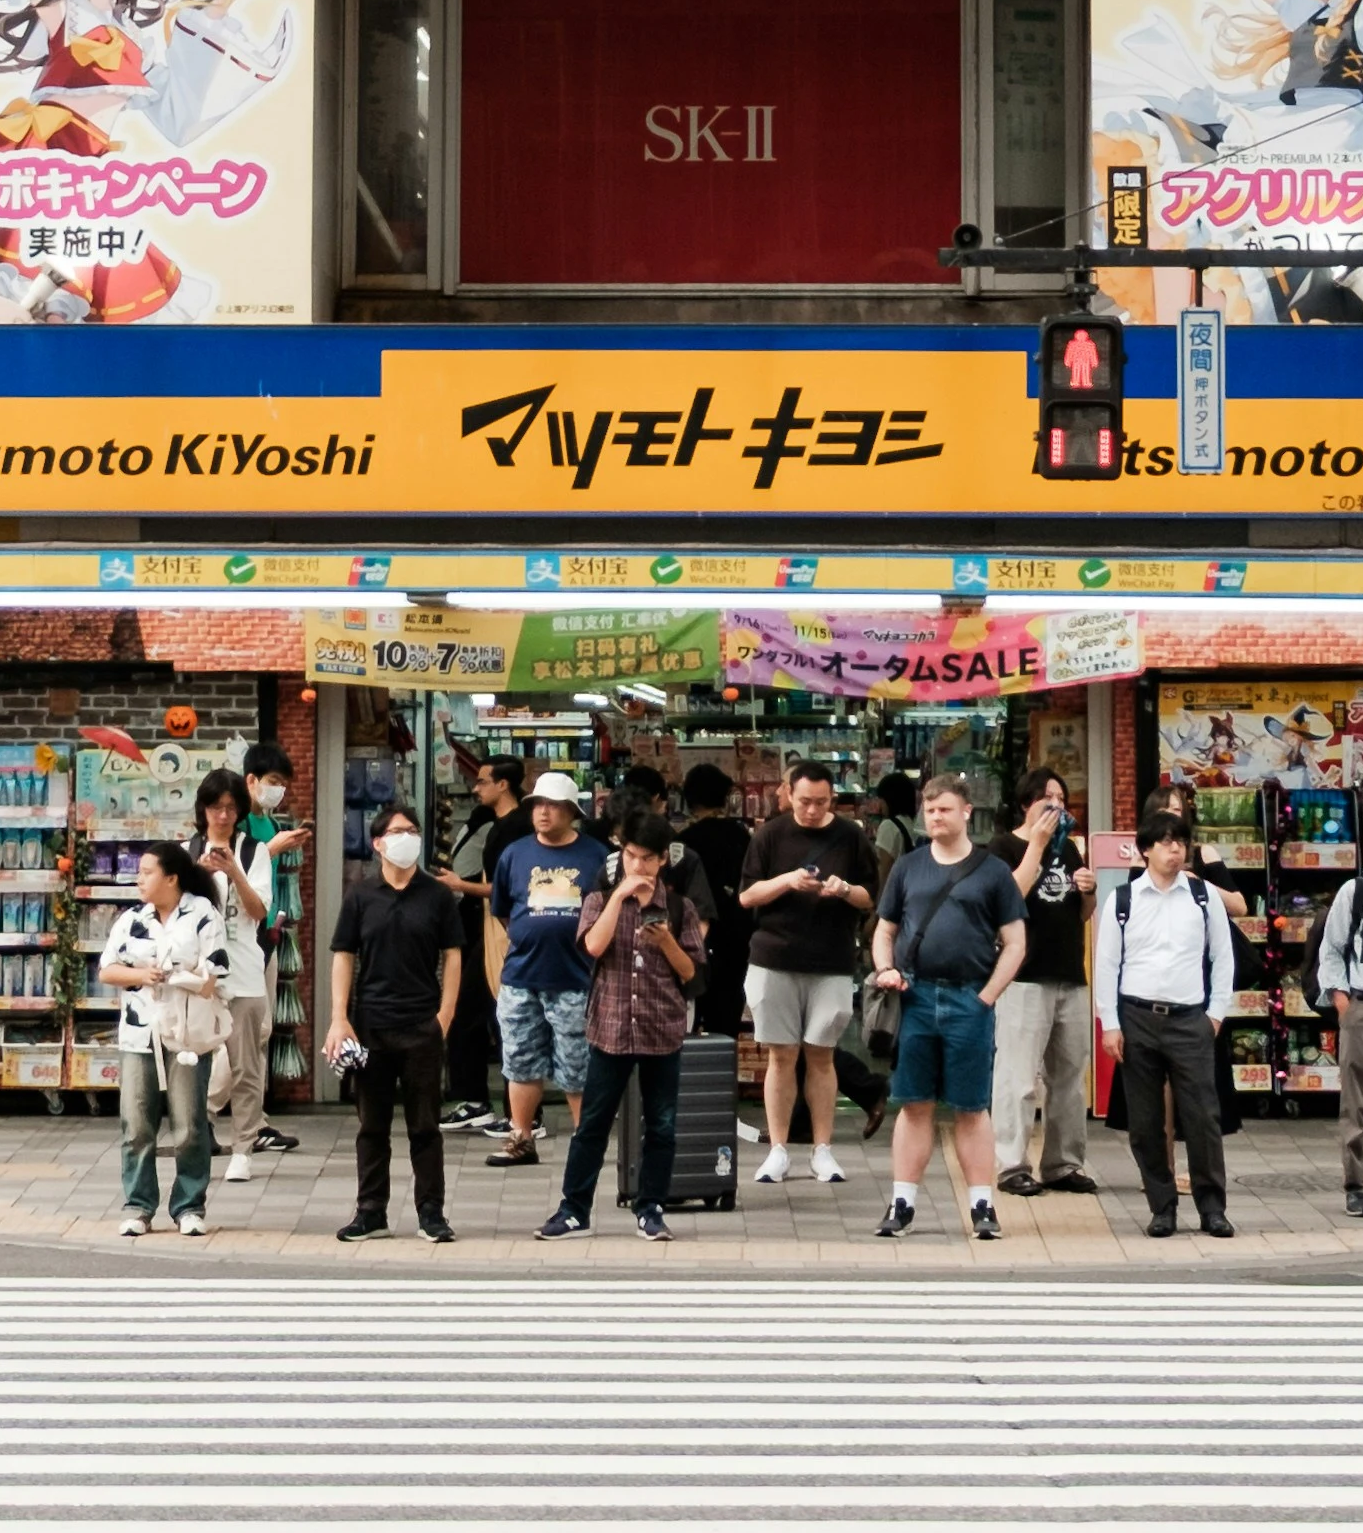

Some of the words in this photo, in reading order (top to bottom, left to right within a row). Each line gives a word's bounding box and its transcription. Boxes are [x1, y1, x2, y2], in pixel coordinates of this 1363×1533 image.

[1113, 190, 1142, 246] 限定
[27, 227, 144, 260] 実施中!
[462, 383, 945, 490] マツモトキヨシ
[164, 432, 375, 476] KiYoshi
[141, 557, 202, 576] 支付宝
[263, 558, 321, 573] 微信支付
[567, 557, 628, 576] 支付宝
[689, 559, 747, 573] 微信支付
[995, 560, 1056, 578] 支付宝
[1117, 563, 1175, 578] 微信支付
[141, 576, 201, 585] ALIPAY
[567, 576, 627, 585] ALIPAY
[995, 578, 1055, 587] ALIPAY
[552, 614, 615, 632] 微信支付
[575, 633, 659, 658] 扫码有礼
[820, 647, 1039, 683] オータムSALE
[1240, 1067, 1268, 1082] 298
